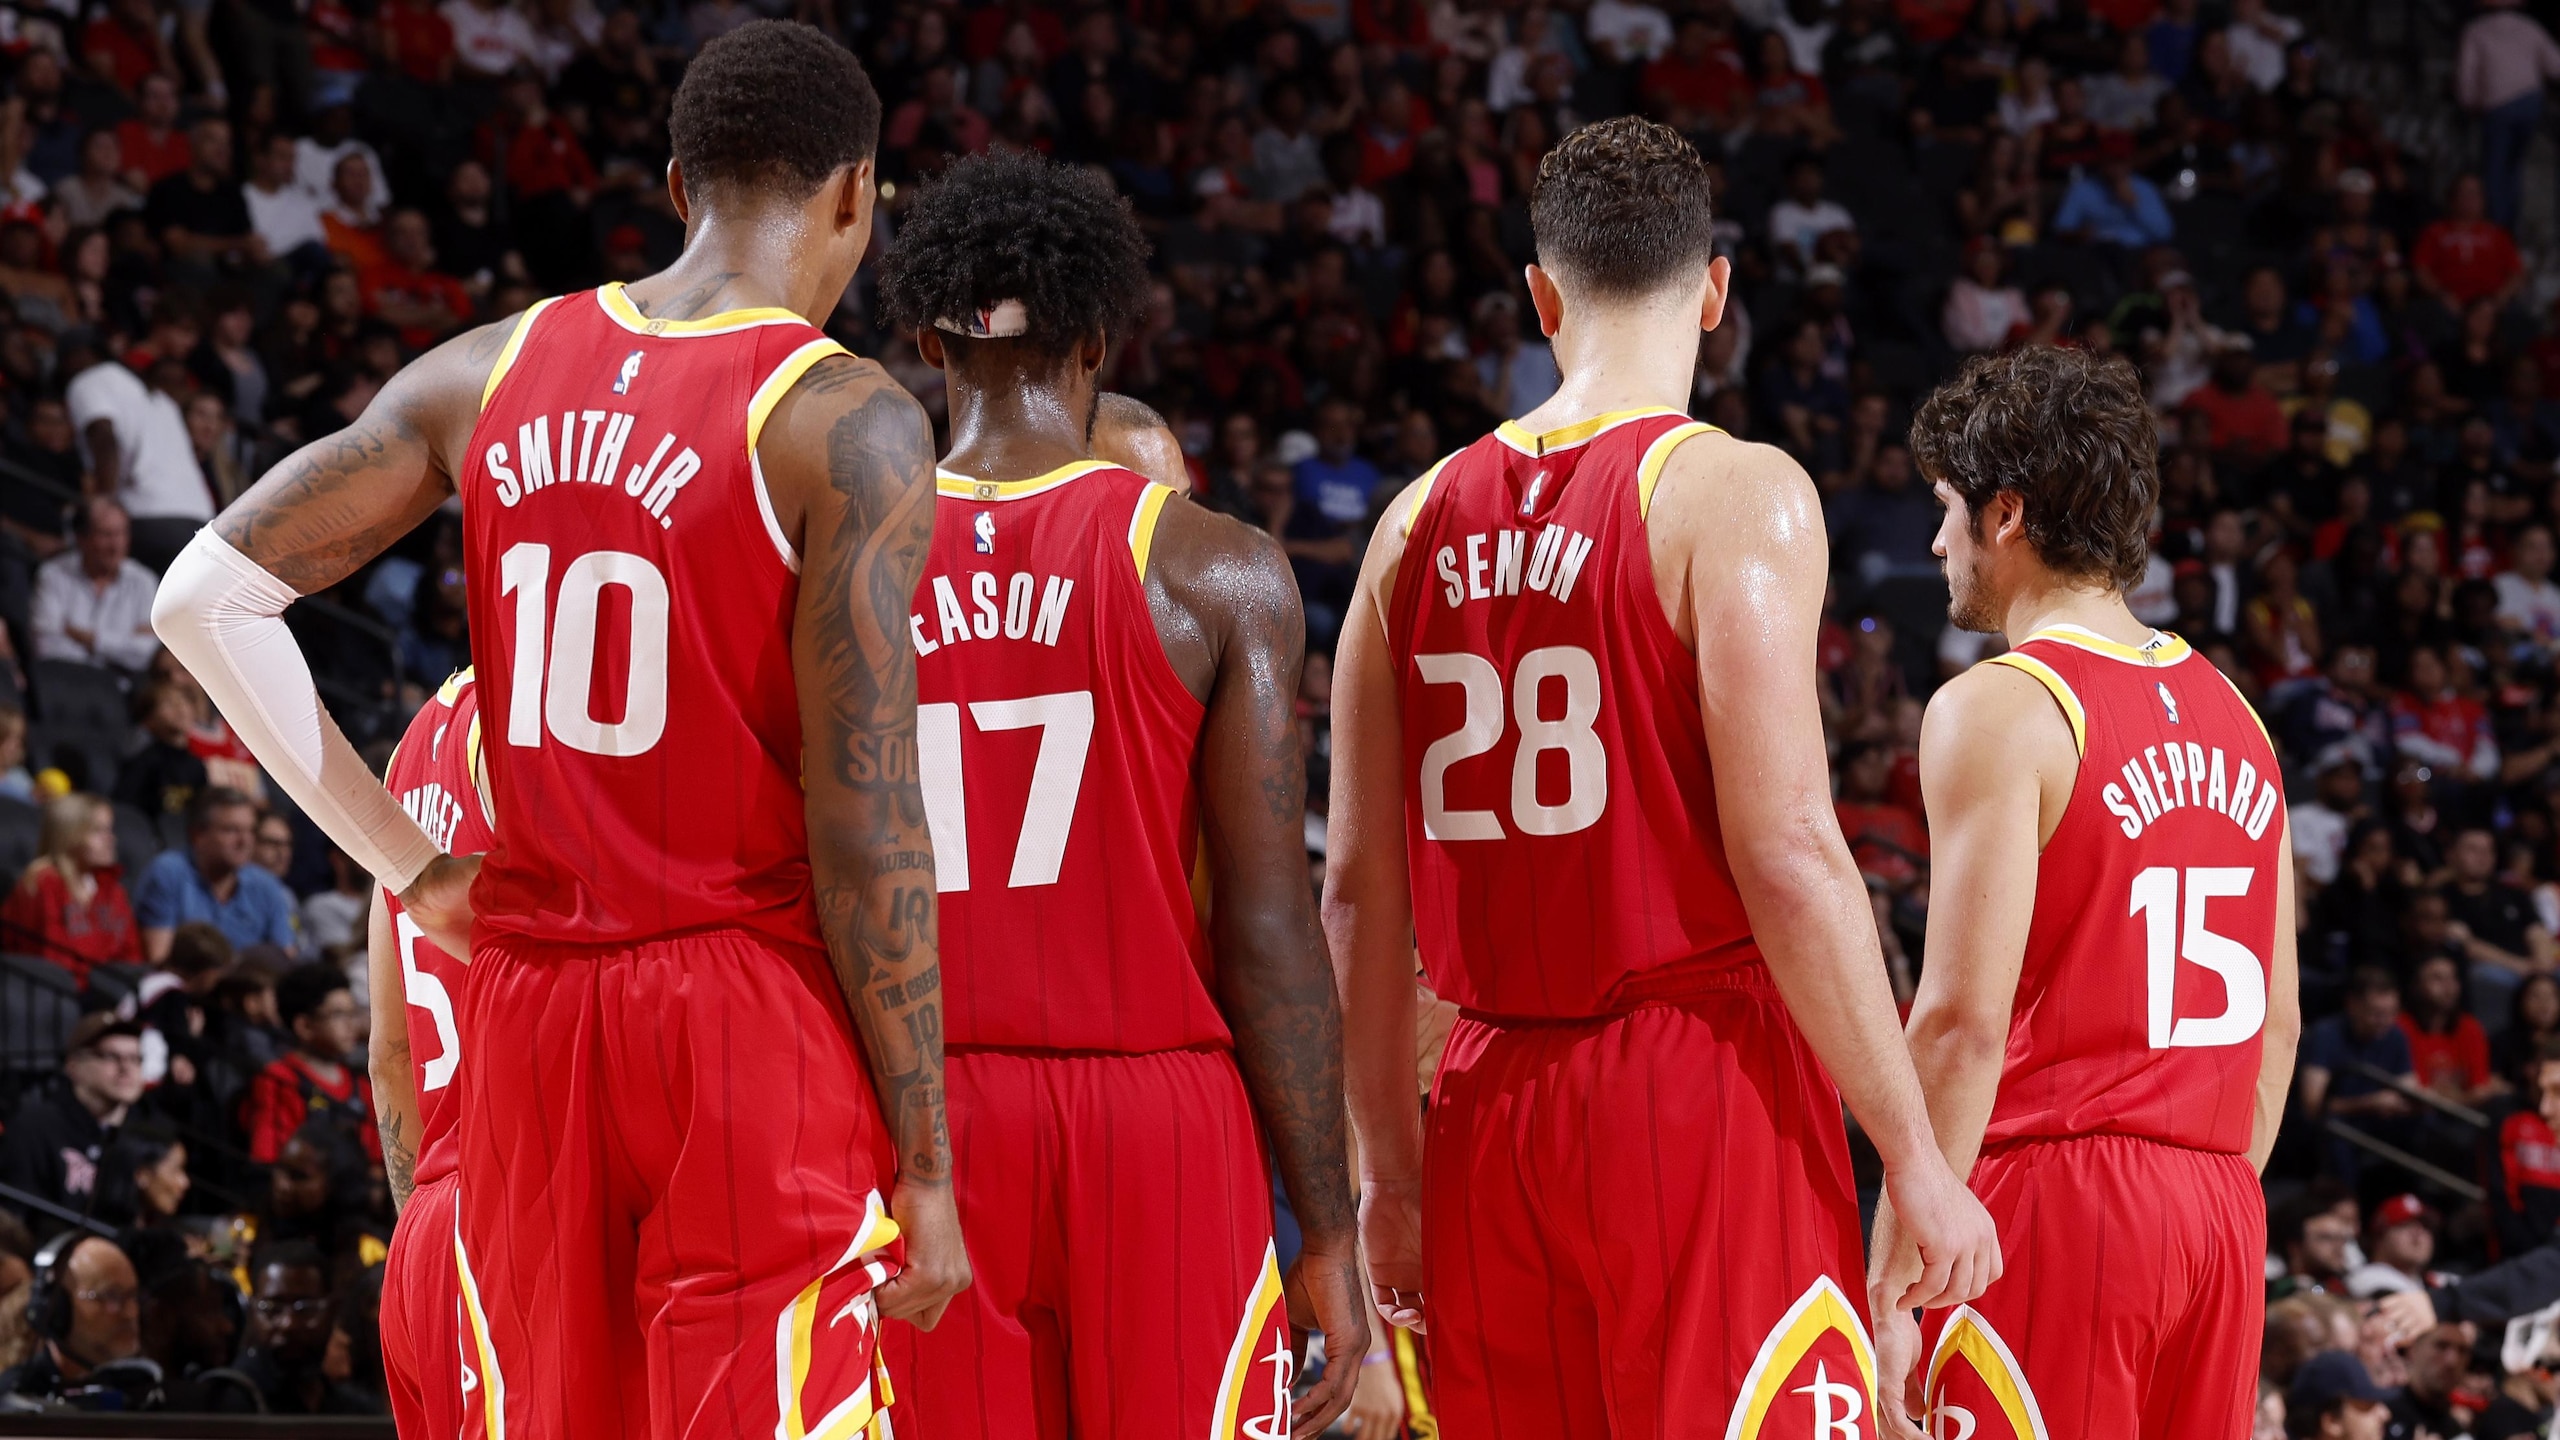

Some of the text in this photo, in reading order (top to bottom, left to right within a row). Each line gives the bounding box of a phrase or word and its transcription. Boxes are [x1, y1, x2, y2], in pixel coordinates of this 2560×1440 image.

[486, 410, 635, 507] SMITH
[625, 432, 702, 530] JR.
[501, 542, 669, 757] 10
[1436, 523, 1594, 608] SENUN
[917, 690, 1095, 892] 17
[1414, 646, 1607, 840] 28
[2102, 741, 2277, 840] SHEPPARD
[396, 911, 461, 1092] 5
[902, 1003, 939, 1050] 10
[2129, 866, 2267, 1049] 15
